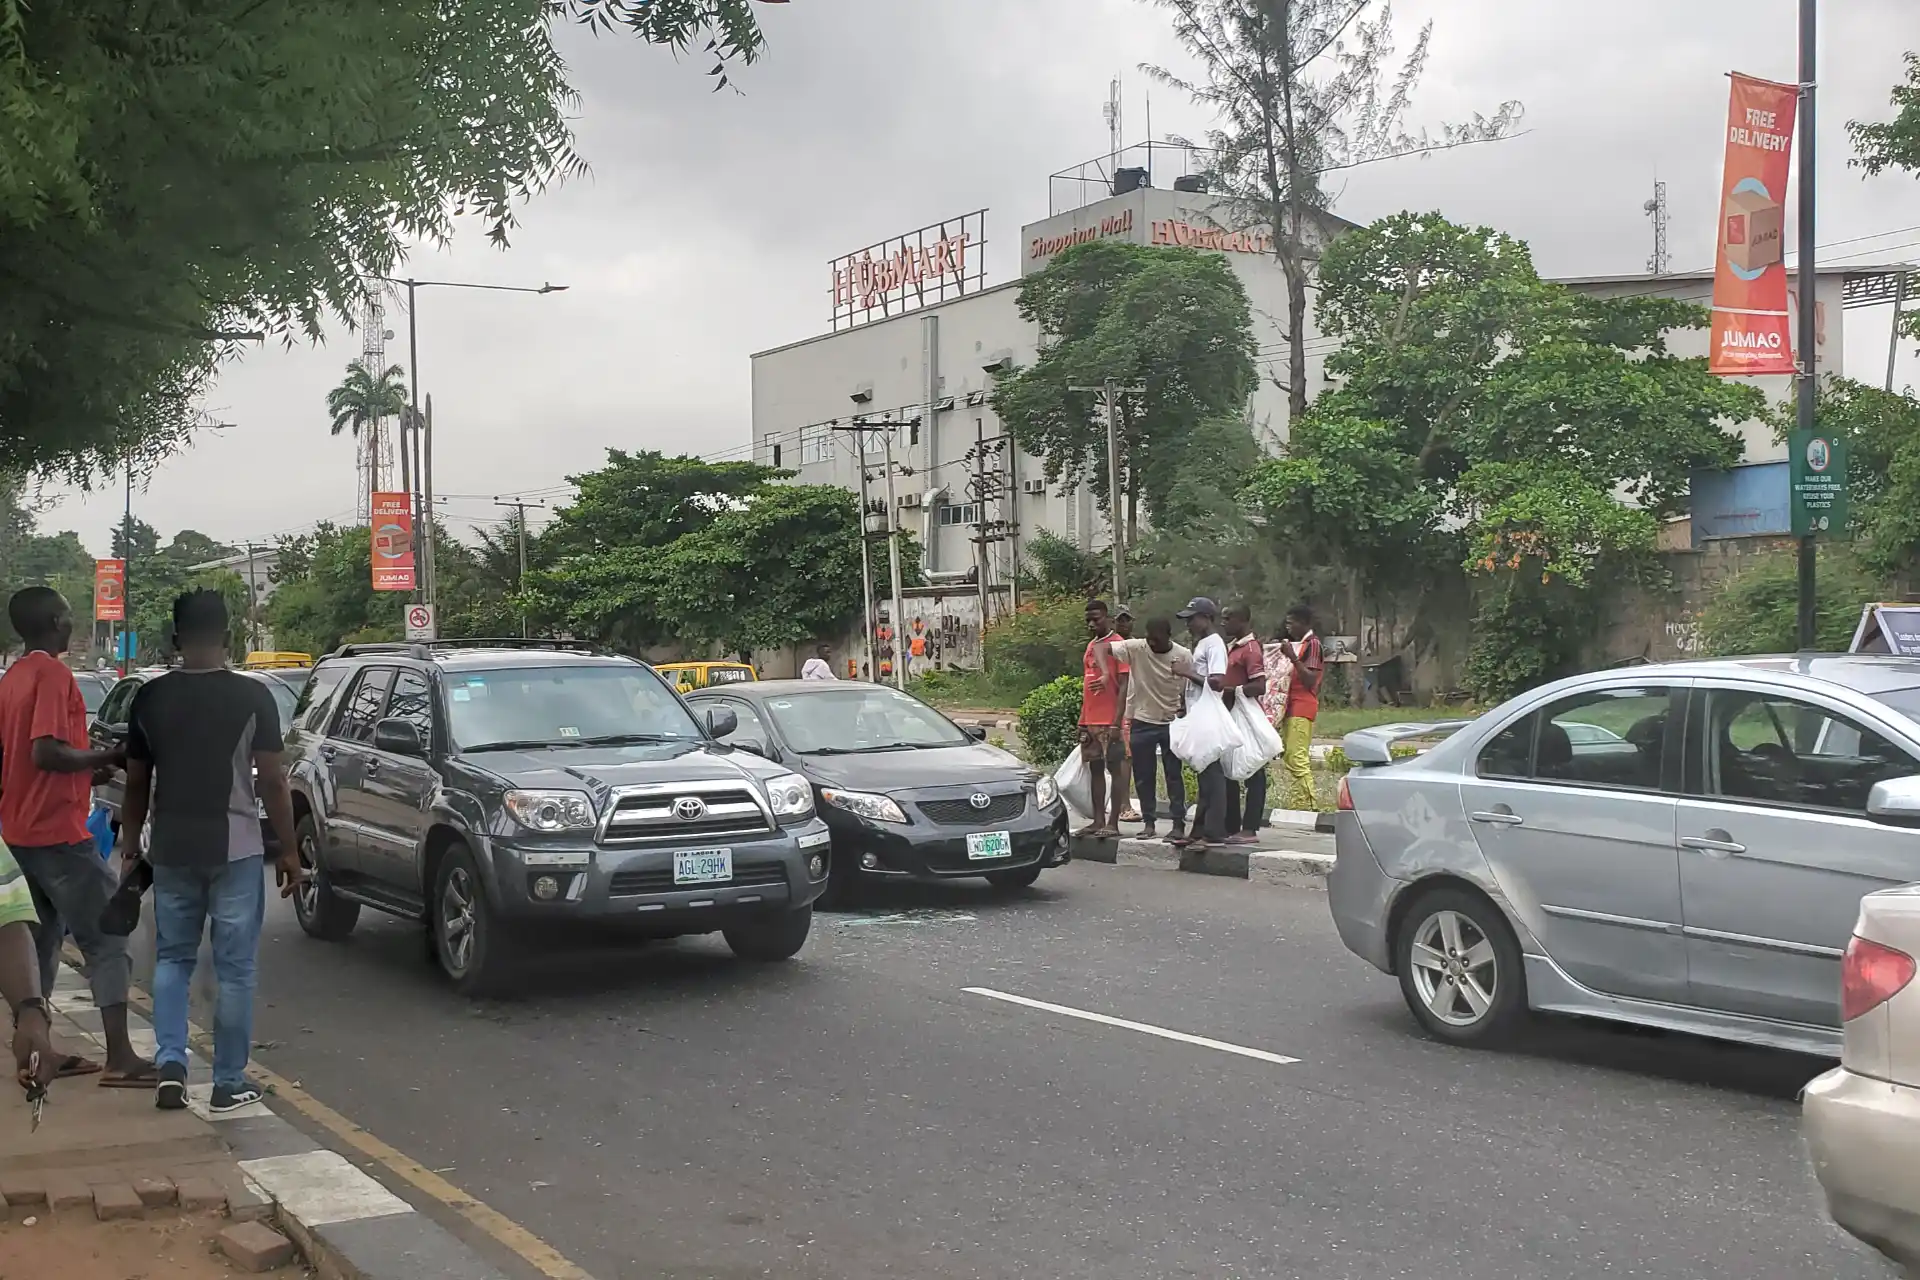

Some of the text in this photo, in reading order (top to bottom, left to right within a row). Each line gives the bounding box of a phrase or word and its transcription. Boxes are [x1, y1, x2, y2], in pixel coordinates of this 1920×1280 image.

[1745, 107, 1777, 129] FREE
[1730, 126, 1789, 152] DELIVERY
[1031, 208, 1134, 259] Shopping Mall
[1806, 501, 1832, 509] PLASTICS
